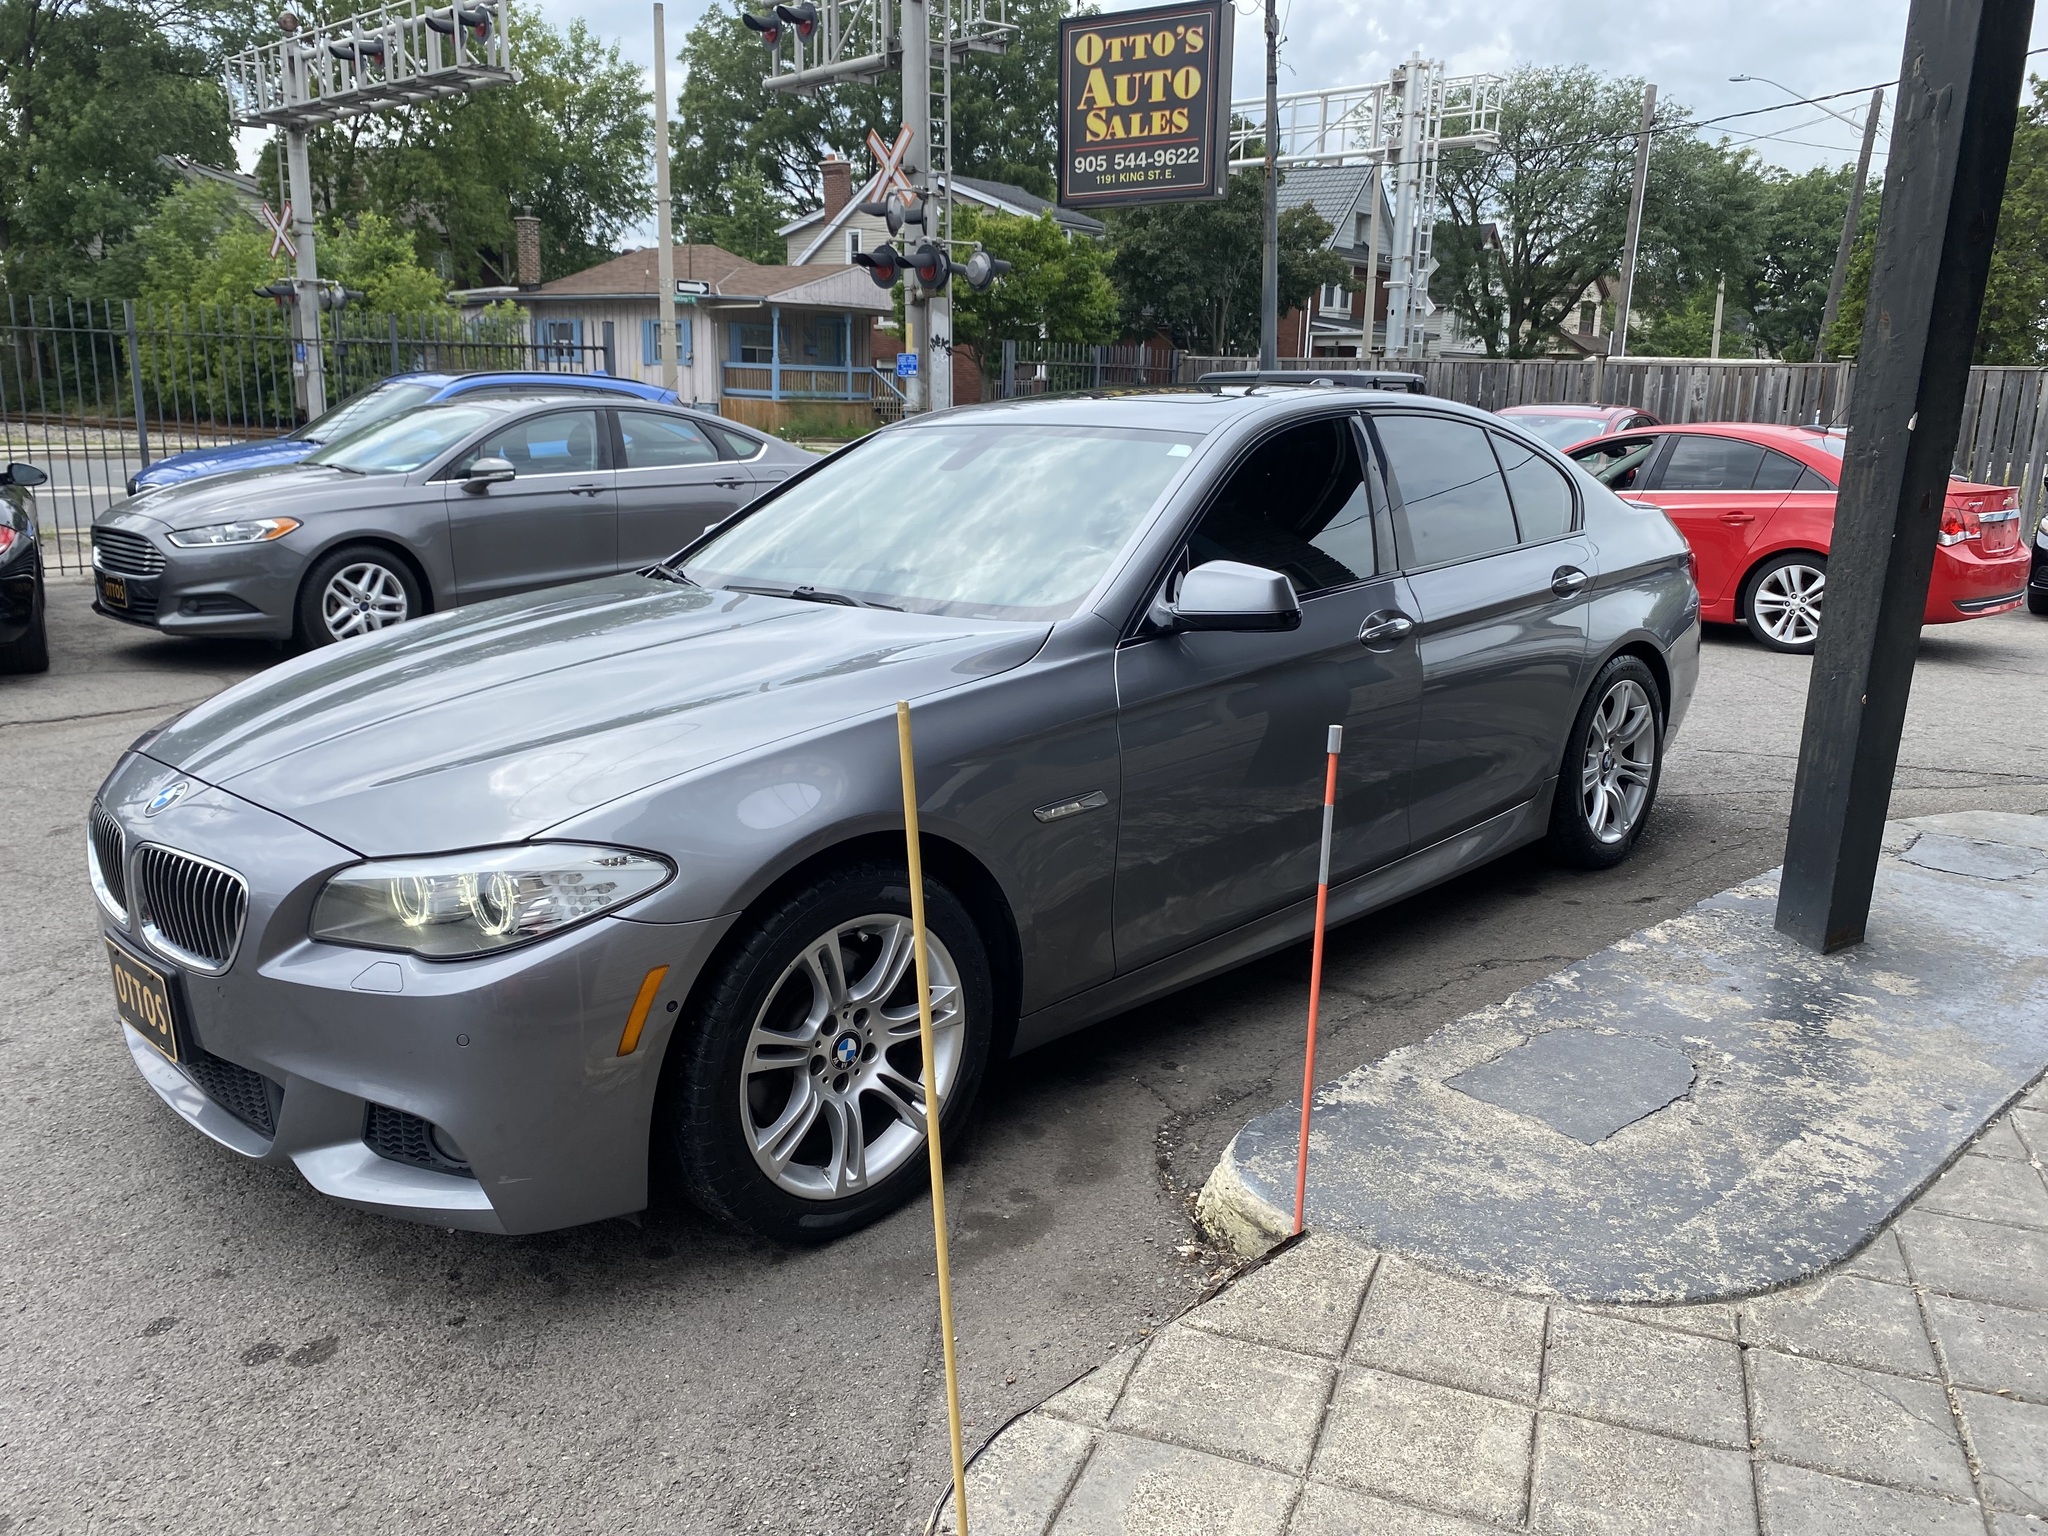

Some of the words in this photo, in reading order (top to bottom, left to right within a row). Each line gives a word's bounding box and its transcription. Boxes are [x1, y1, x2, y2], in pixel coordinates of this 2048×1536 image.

[1075, 24, 1204, 66] OTTO'S
[1077, 66, 1201, 110] AUTO
[1086, 107, 1189, 142] SALES
[1074, 155, 1107, 173] 905
[1114, 147, 1199, 170] 544-9622
[1096, 173, 1116, 184] 1191
[1119, 171, 1145, 183] KING
[1148, 170, 1163, 181] ST.
[1165, 169, 1176, 179] E.
[105, 582, 124, 599] OTTOS
[115, 963, 167, 1035] OTTOS
